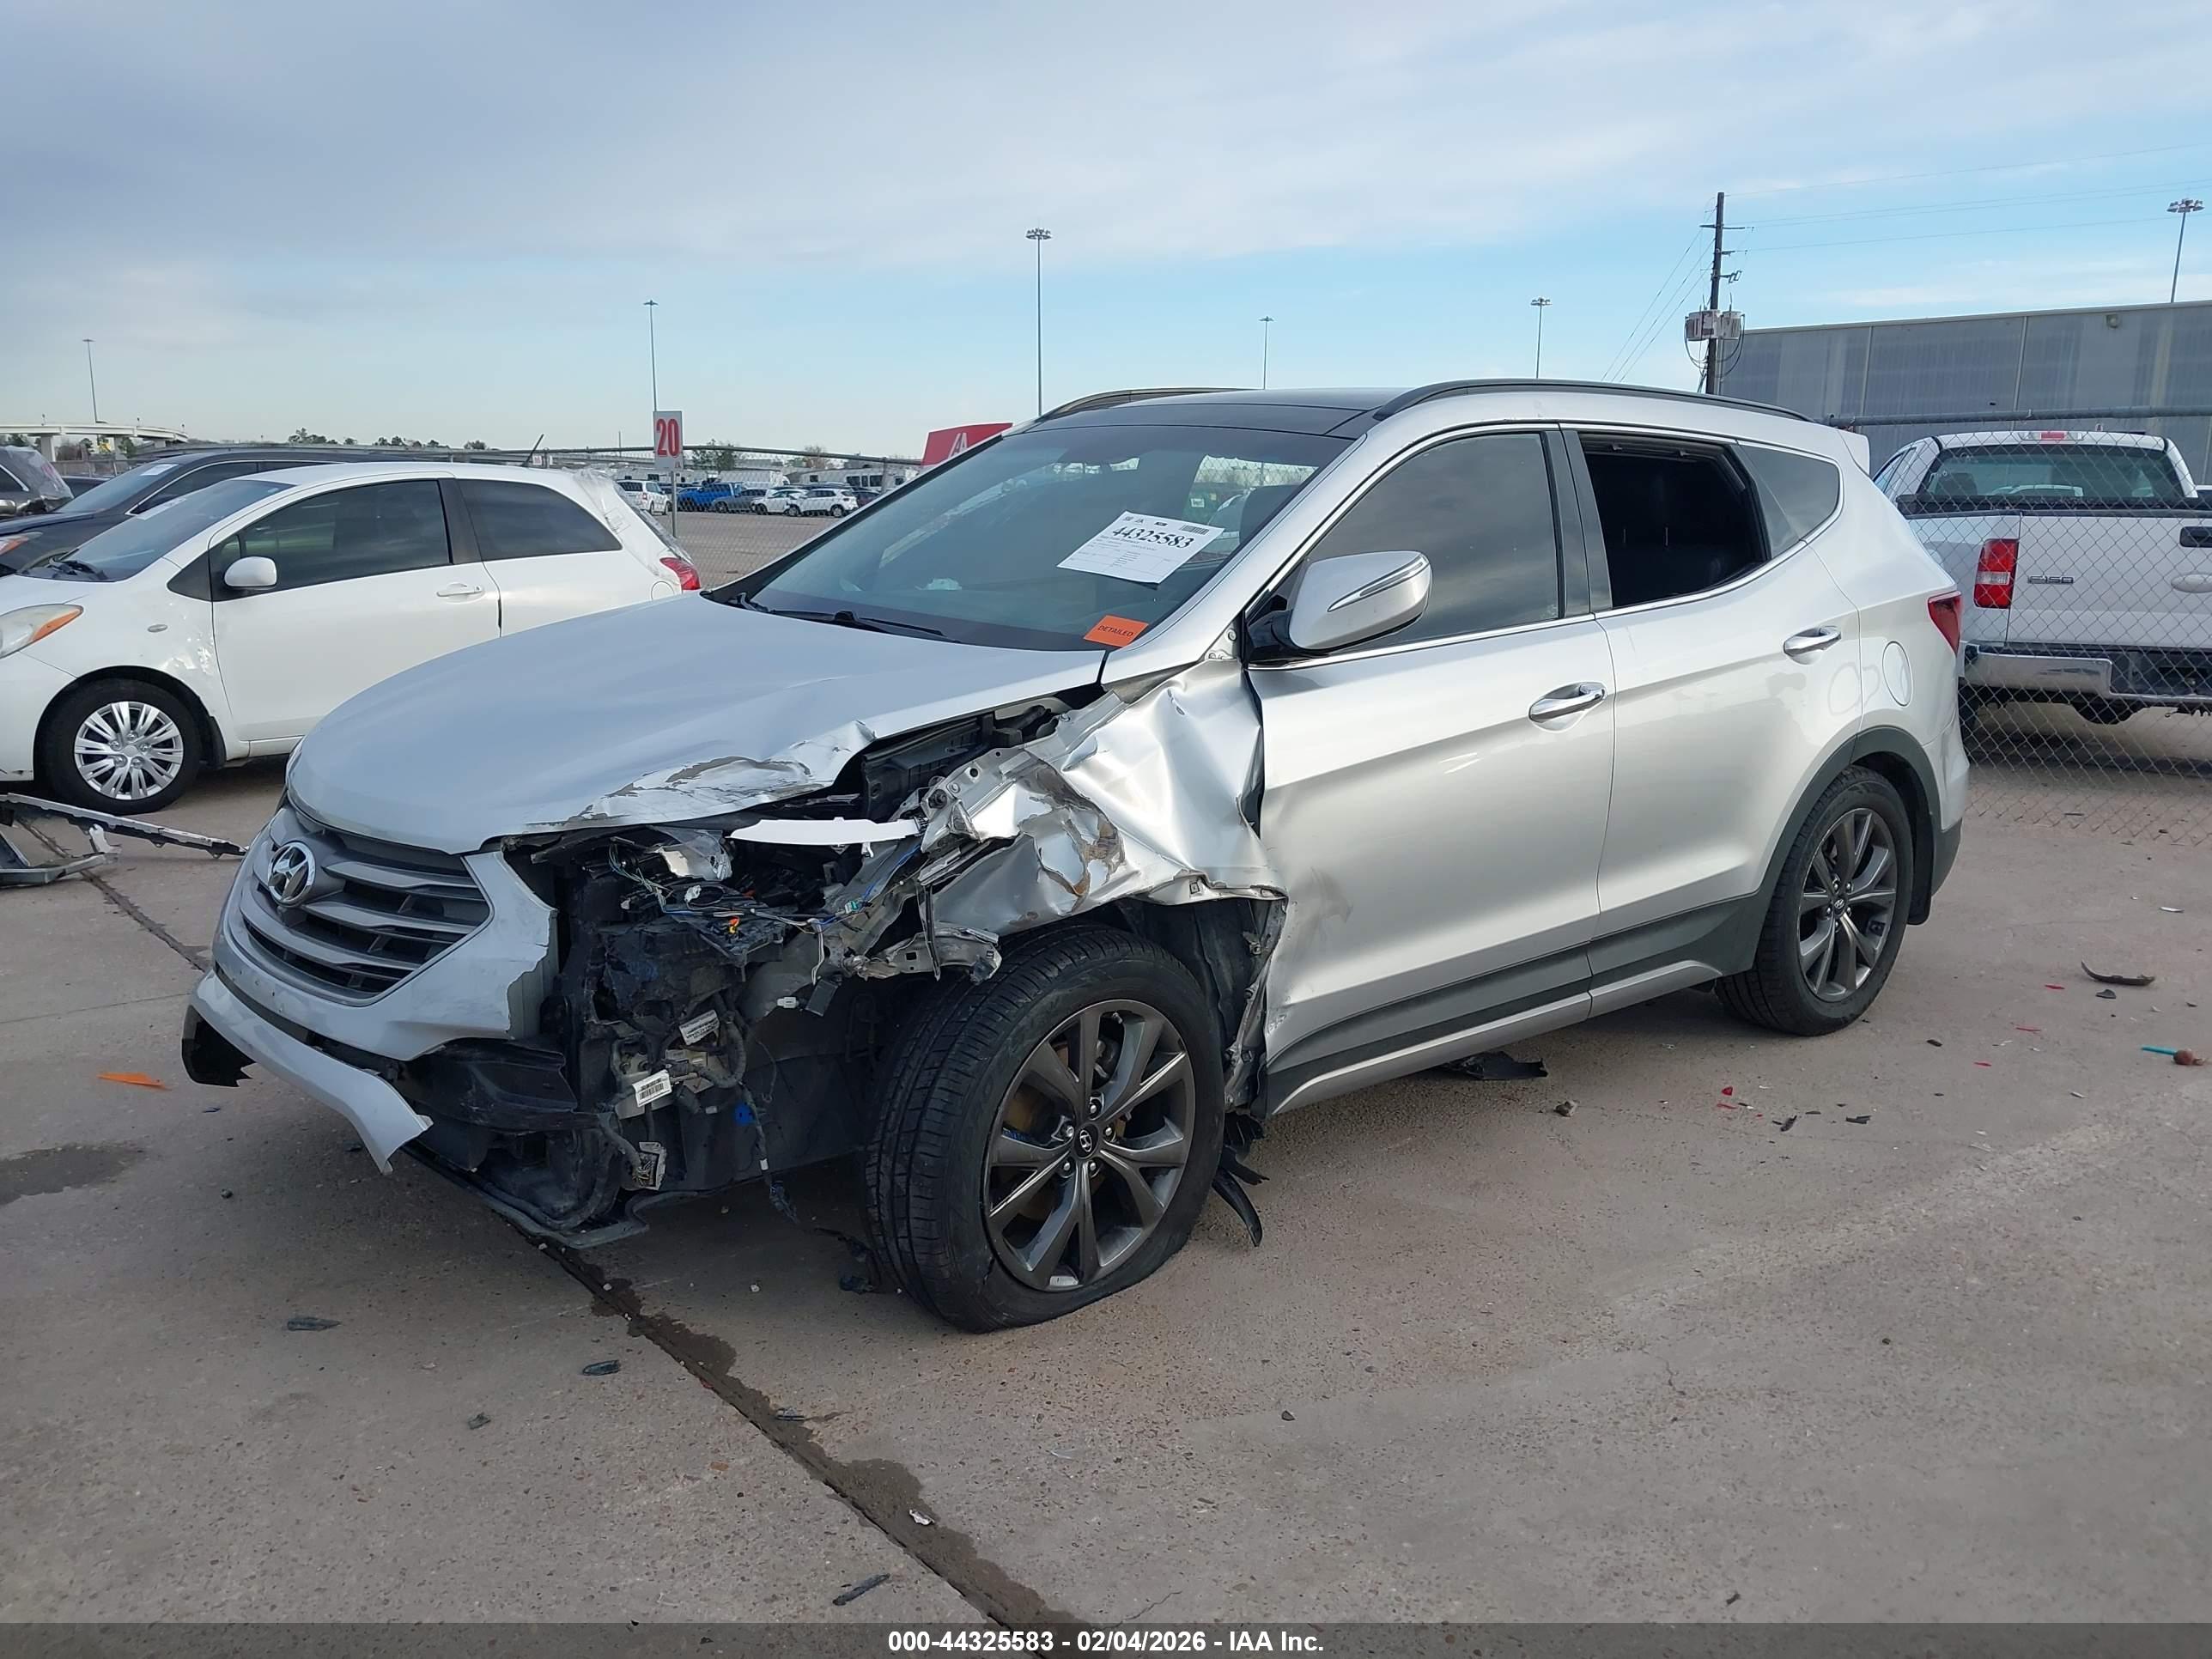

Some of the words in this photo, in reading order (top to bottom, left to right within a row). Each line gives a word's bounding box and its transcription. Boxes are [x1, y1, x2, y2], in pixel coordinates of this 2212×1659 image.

[656, 418, 680, 457] 20
[1113, 526, 1194, 549] 44325583
[1097, 624, 1134, 637] DETAILED
